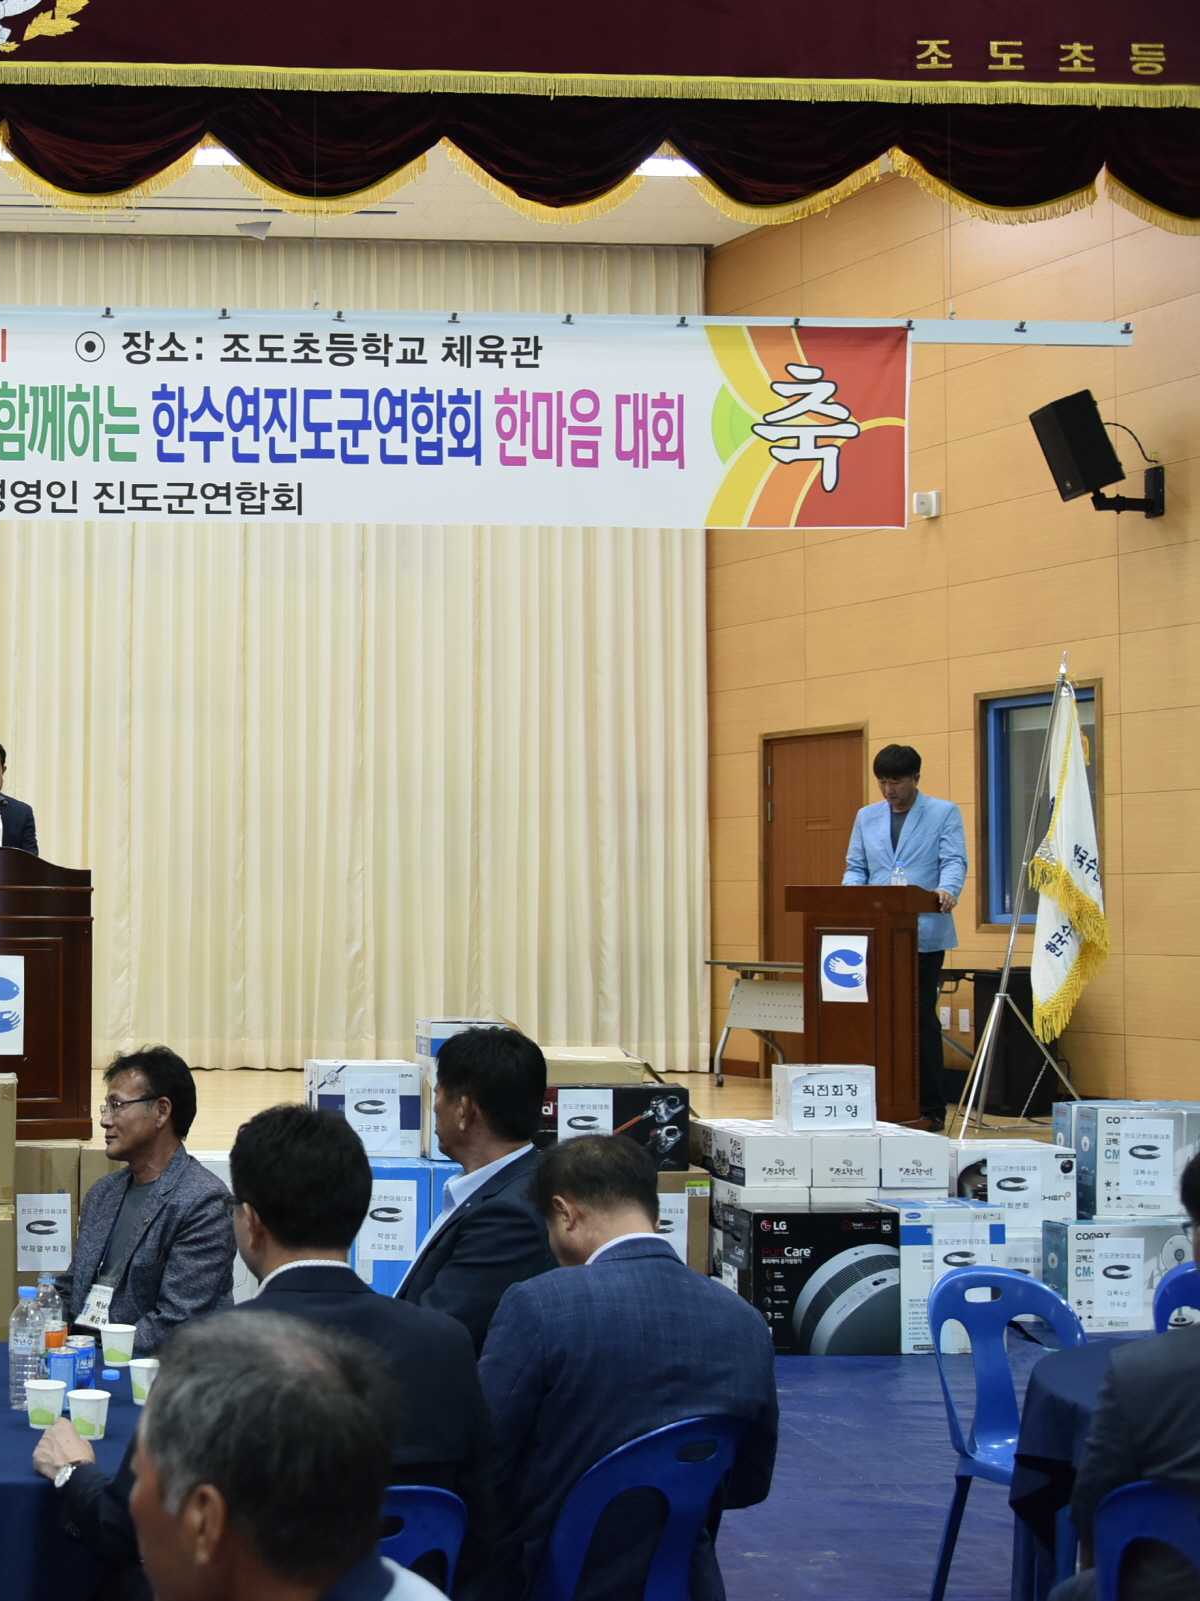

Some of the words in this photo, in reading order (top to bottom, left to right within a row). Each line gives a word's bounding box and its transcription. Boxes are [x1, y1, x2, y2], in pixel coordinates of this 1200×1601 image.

[121, 331, 204, 365] 장소:
[220, 331, 429, 369] 조도초등학교
[441, 333, 544, 369] 체육관
[152, 383, 483, 467] 한수연진도군연합회
[494, 386, 603, 469] 한마음
[614, 391, 686, 470] 대회
[750, 362, 861, 494] 축
[92, 480, 304, 517] 진도군연합회
[802, 1084, 858, 1097] 직전회장
[803, 1104, 858, 1118] 김기영
[356, 1124, 388, 1133] 고군분회
[773, 1221, 787, 1231] LG
